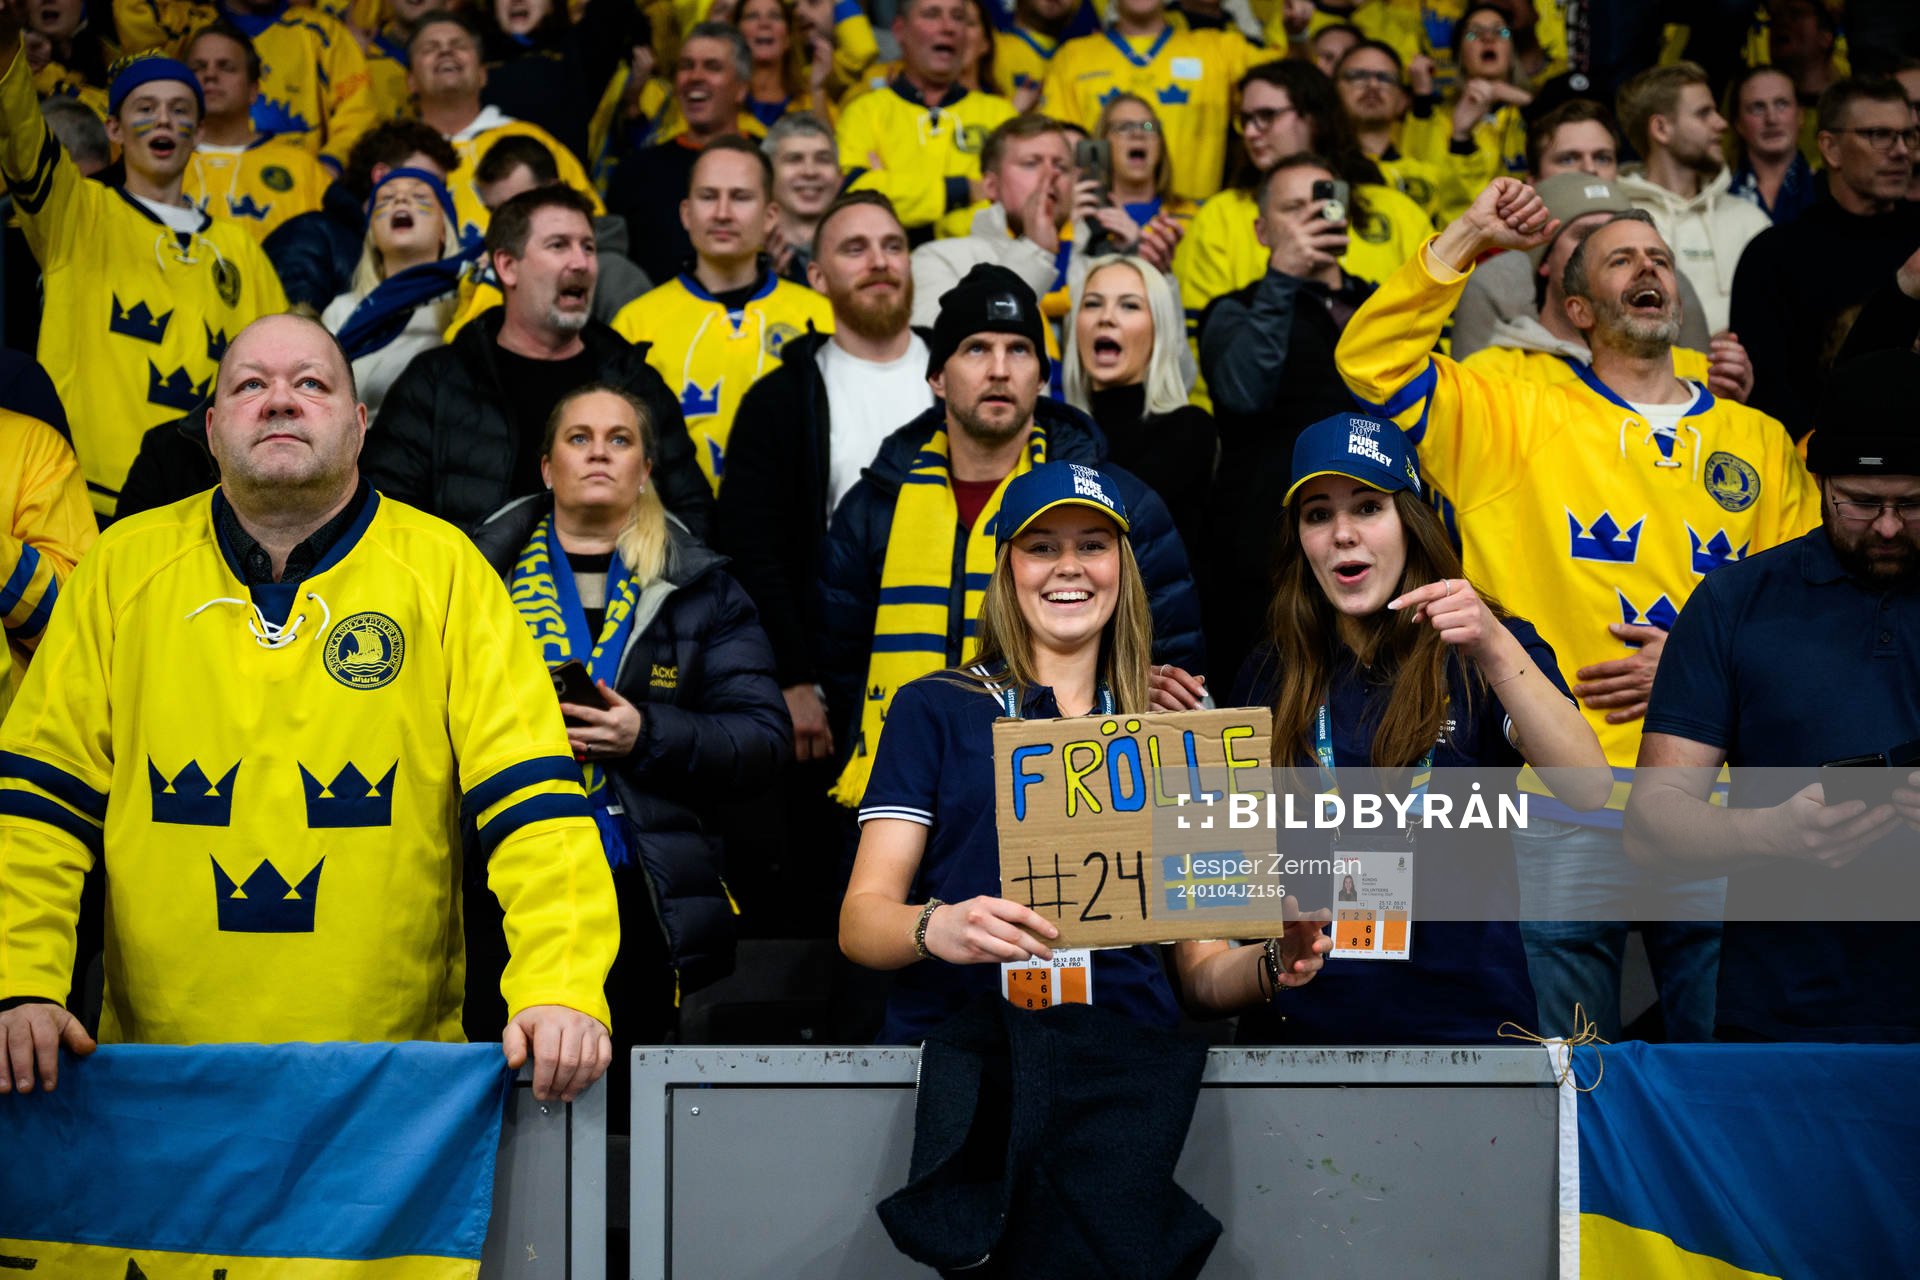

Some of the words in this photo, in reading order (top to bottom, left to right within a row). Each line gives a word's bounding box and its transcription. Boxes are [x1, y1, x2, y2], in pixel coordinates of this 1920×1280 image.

[1349, 418, 1381, 432] PURE
[1350, 425, 1373, 438] JOY
[1349, 433, 1380, 452] PURE
[1348, 443, 1393, 467] HOCKEY
[1073, 476, 1103, 494] PURE
[1074, 484, 1115, 509] HOCKEY
[1011, 719, 1266, 822] FRÖLLE
[1011, 850, 1147, 922] #24
[1353, 911, 1359, 921] 2
[1366, 912, 1373, 921] 3
[1365, 925, 1372, 934] 6
[1351, 937, 1358, 947] 8
[1364, 937, 1371, 947] 9
[1012, 971, 1017, 981] 1
[1026, 971, 1032, 981] 2
[1040, 970, 1047, 980] 3
[1040, 984, 1048, 994] 6
[1026, 998, 1033, 1008] 8
[1041, 998, 1048, 1008] 9
